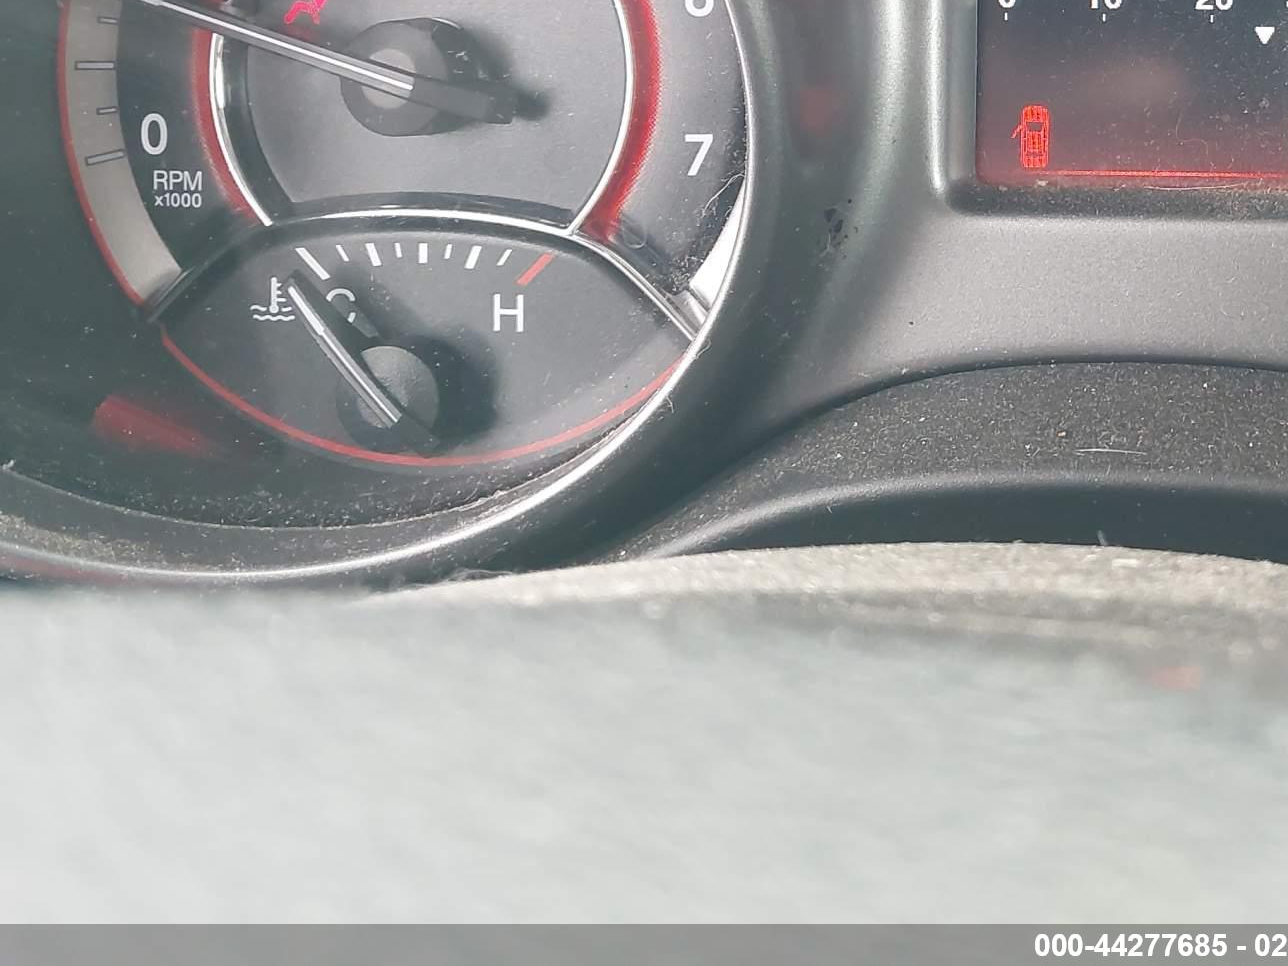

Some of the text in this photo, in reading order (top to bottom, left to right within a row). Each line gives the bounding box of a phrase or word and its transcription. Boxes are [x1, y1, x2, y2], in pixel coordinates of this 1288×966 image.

[141, 114, 167, 154] 0
[685, 135, 714, 175] 7
[153, 171, 203, 191] RPM
[154, 193, 203, 208] x1000
[493, 294, 524, 332] H
